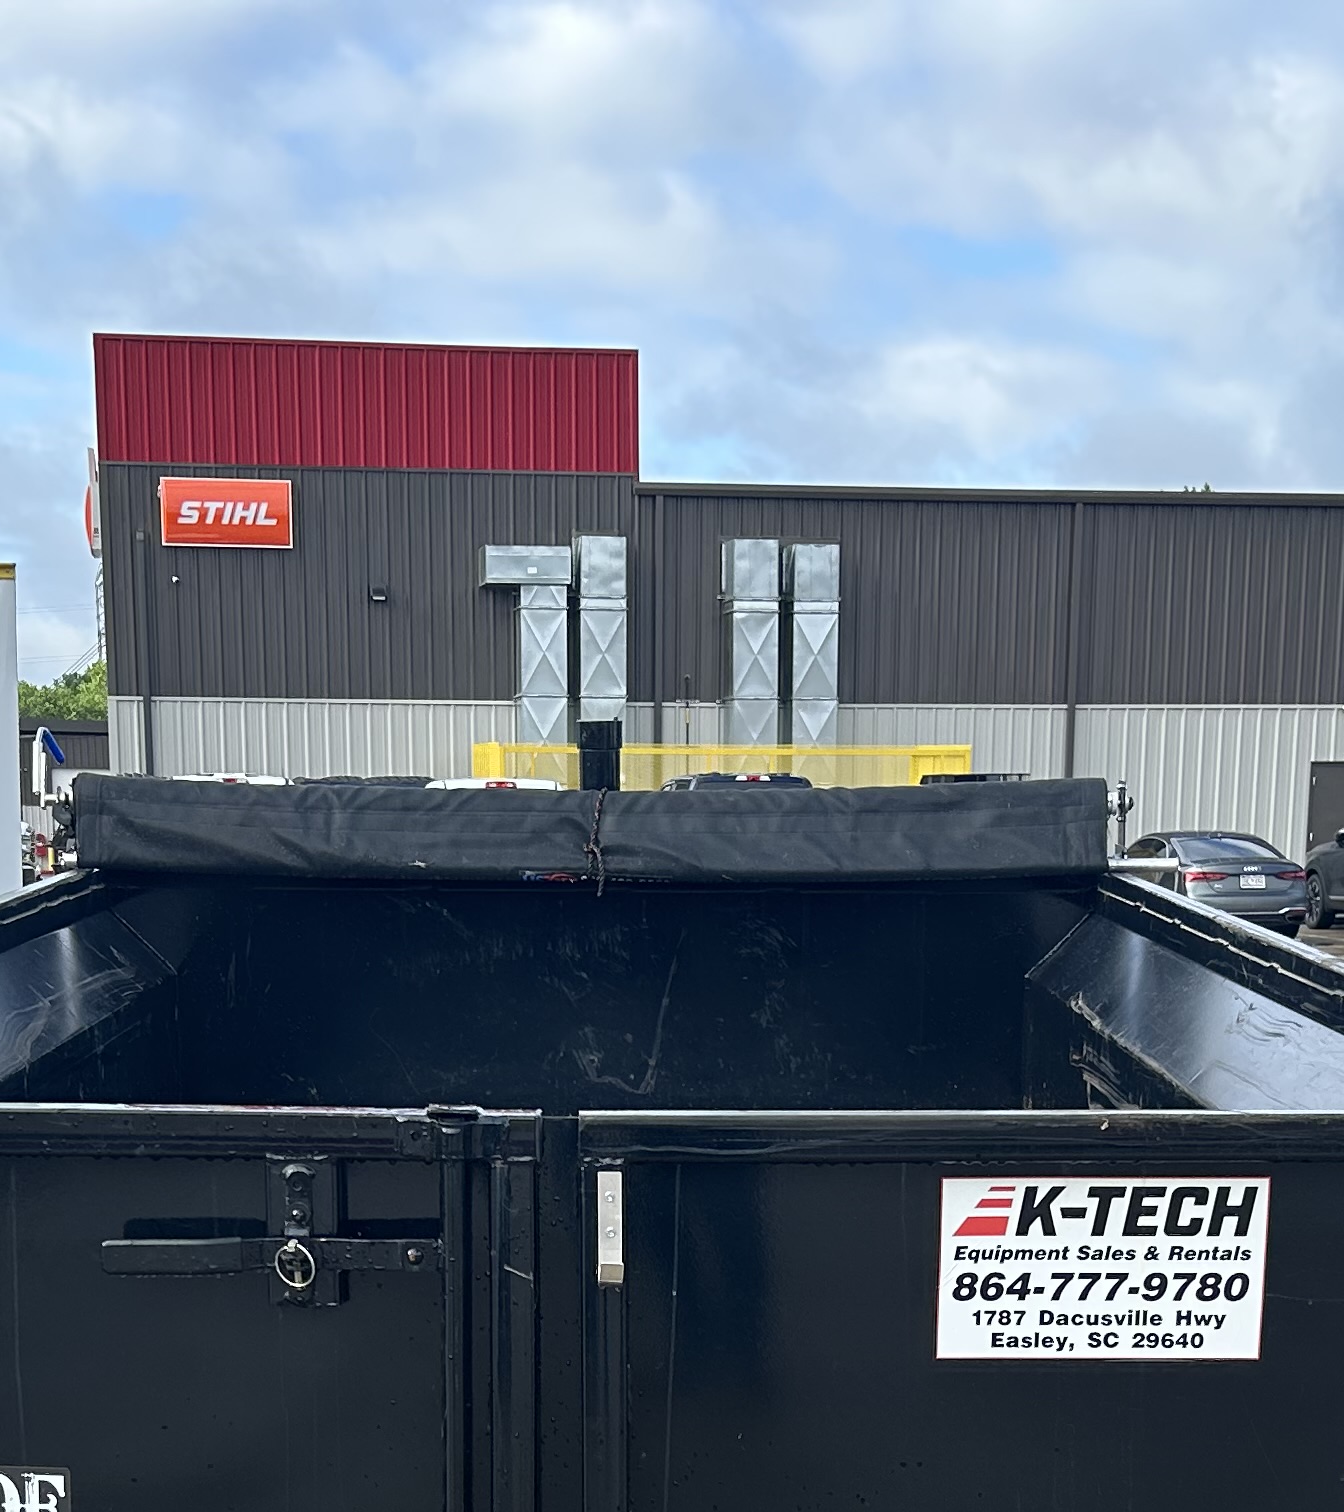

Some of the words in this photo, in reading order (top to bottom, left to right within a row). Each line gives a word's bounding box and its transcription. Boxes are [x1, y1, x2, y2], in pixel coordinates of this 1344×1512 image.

[176, 500, 278, 526] STIHL
[1015, 1186, 1259, 1237] K-TECH
[953, 1245, 1069, 1264] Equipment
[1076, 1245, 1137, 1262] Sales
[1143, 1246, 1160, 1261] &
[1167, 1245, 1252, 1262] Rentals
[951, 1272, 1250, 1302] 864-777-9780
[971, 1310, 1026, 1326] 1787
[1038, 1309, 1164, 1327] Dacusville
[1175, 1310, 1227, 1330] Hwy
[990, 1332, 1075, 1352] Easley,
[1087, 1332, 1120, 1349] SC
[1131, 1332, 1205, 1349] 29640
